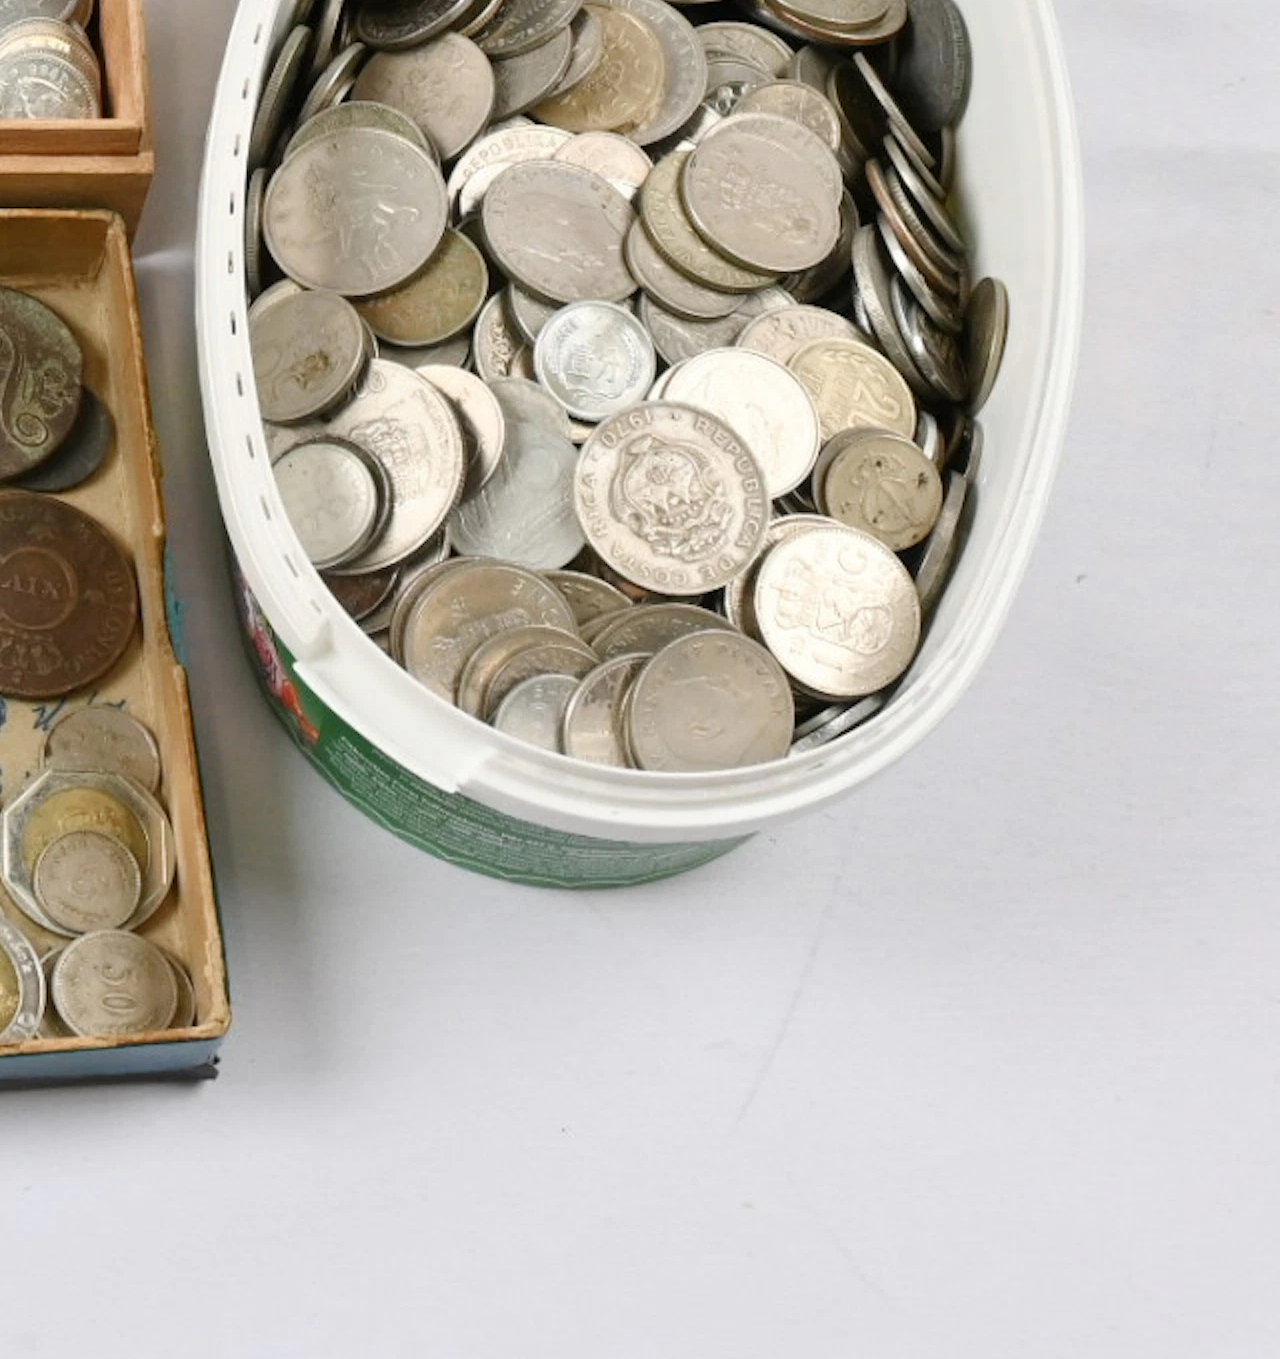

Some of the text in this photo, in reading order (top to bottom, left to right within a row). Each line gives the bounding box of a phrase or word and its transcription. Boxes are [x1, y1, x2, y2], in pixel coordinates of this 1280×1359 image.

[580, 474, 609, 539] RICA
[692, 414, 762, 549] REPUBLICA
[609, 543, 689, 585] COSTA
